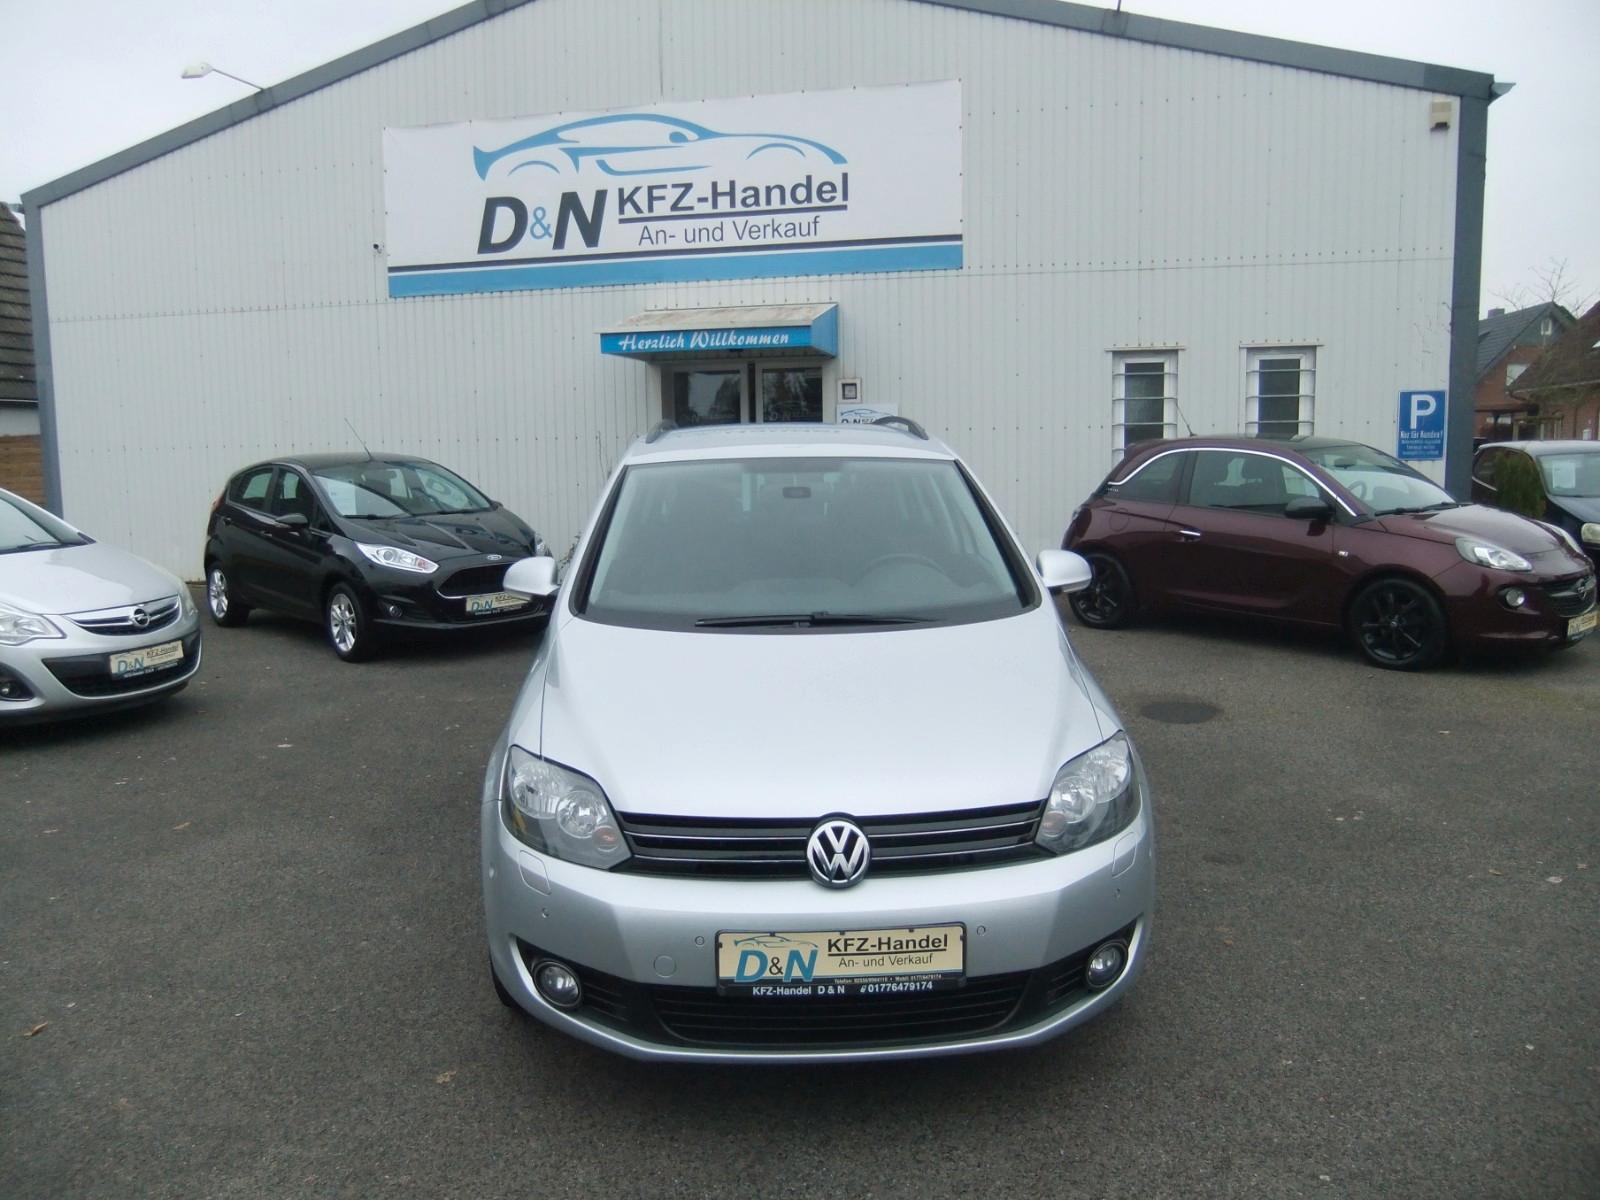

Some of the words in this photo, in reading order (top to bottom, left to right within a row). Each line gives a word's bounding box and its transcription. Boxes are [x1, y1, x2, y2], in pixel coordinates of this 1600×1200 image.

[617, 172, 849, 216] KFZ-Handel
[477, 189, 608, 255] D&N
[638, 225, 677, 247] An-
[683, 220, 725, 243] und
[732, 215, 820, 241] Verkauf
[618, 333, 685, 350] Herzlich
[690, 330, 789, 348] Willkommen
[1410, 394, 1437, 430] P
[827, 934, 948, 953] KFZ-Handel
[734, 948, 819, 983] D&N
[838, 957, 859, 968] An-
[863, 956, 886, 967] und
[888, 953, 933, 967] Verkauf
[752, 985, 812, 996] KFZ-Handel
